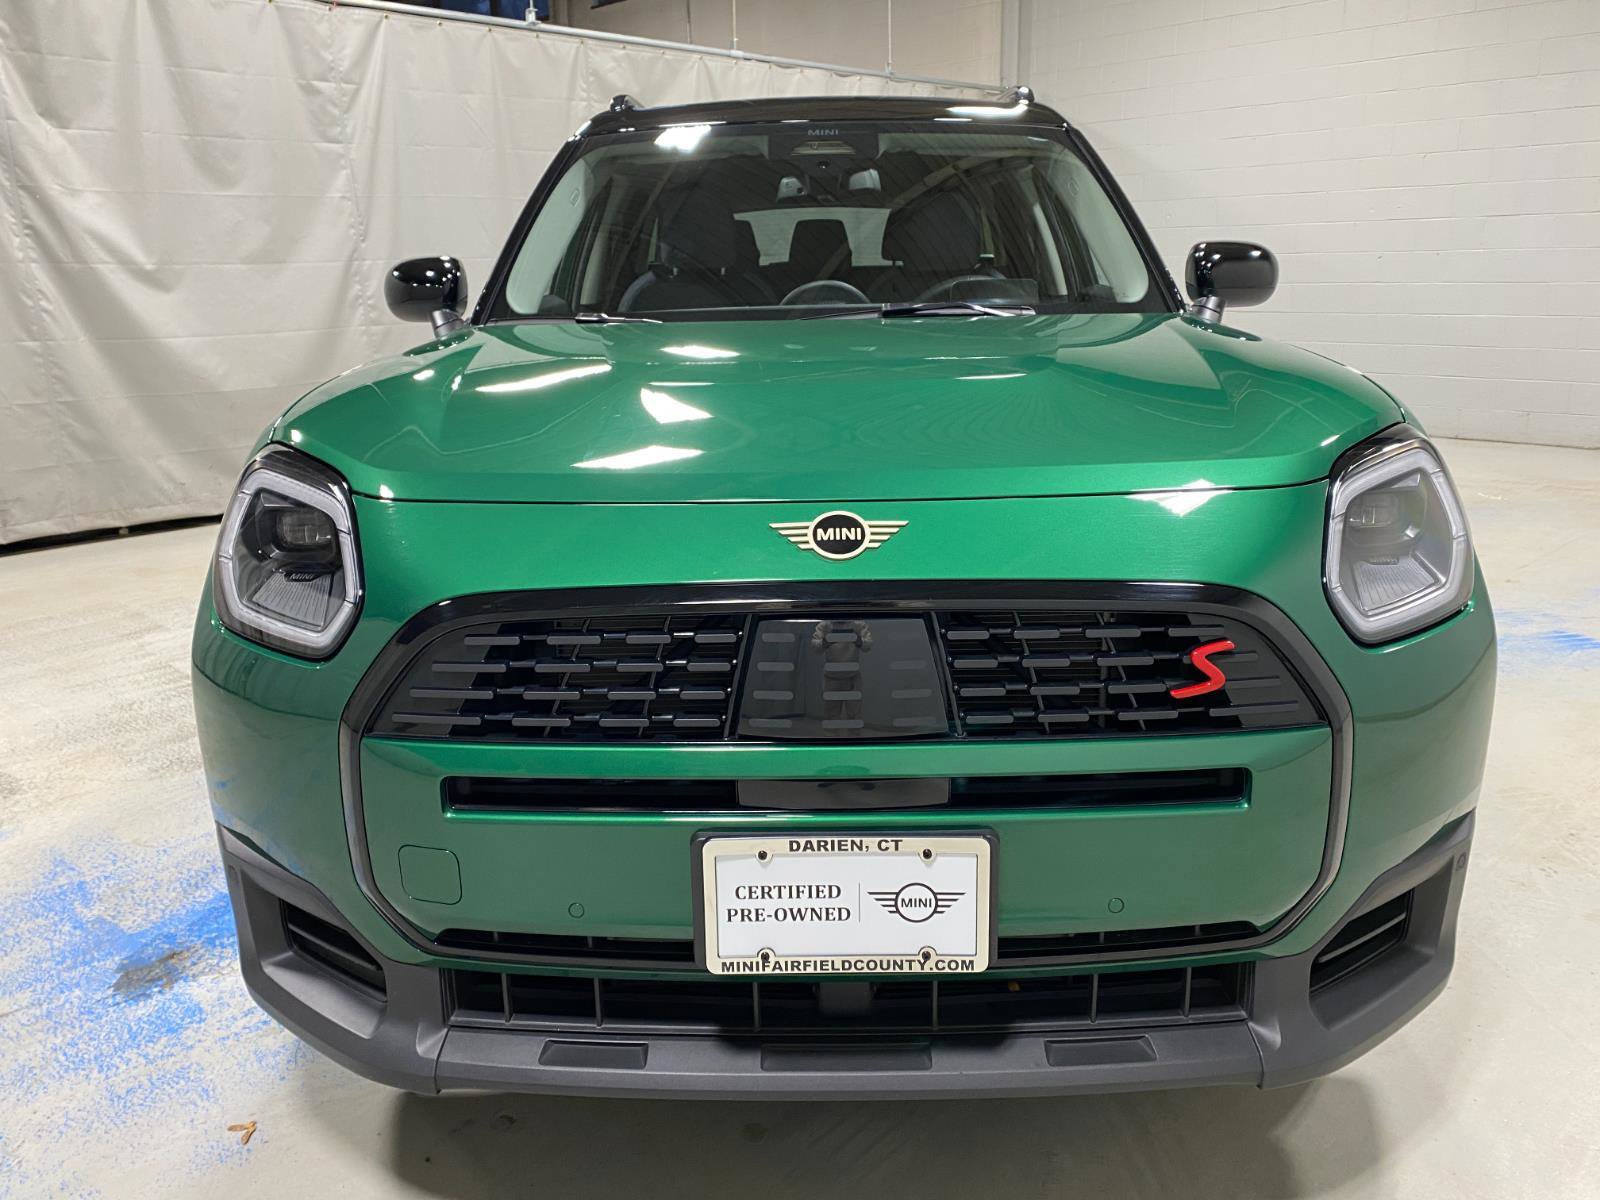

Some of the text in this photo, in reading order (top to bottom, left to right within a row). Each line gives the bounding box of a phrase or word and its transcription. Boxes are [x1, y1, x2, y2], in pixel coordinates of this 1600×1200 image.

[816, 527, 862, 541] MINI
[1170, 640, 1236, 699] S
[788, 839, 903, 853] DARIEN, CT
[735, 884, 842, 900] CERTIFIED
[900, 897, 932, 908] MINI
[726, 906, 851, 923] PRE-OWNED
[721, 959, 975, 973] MINIFAIRFIELDCOUNTY.COM
